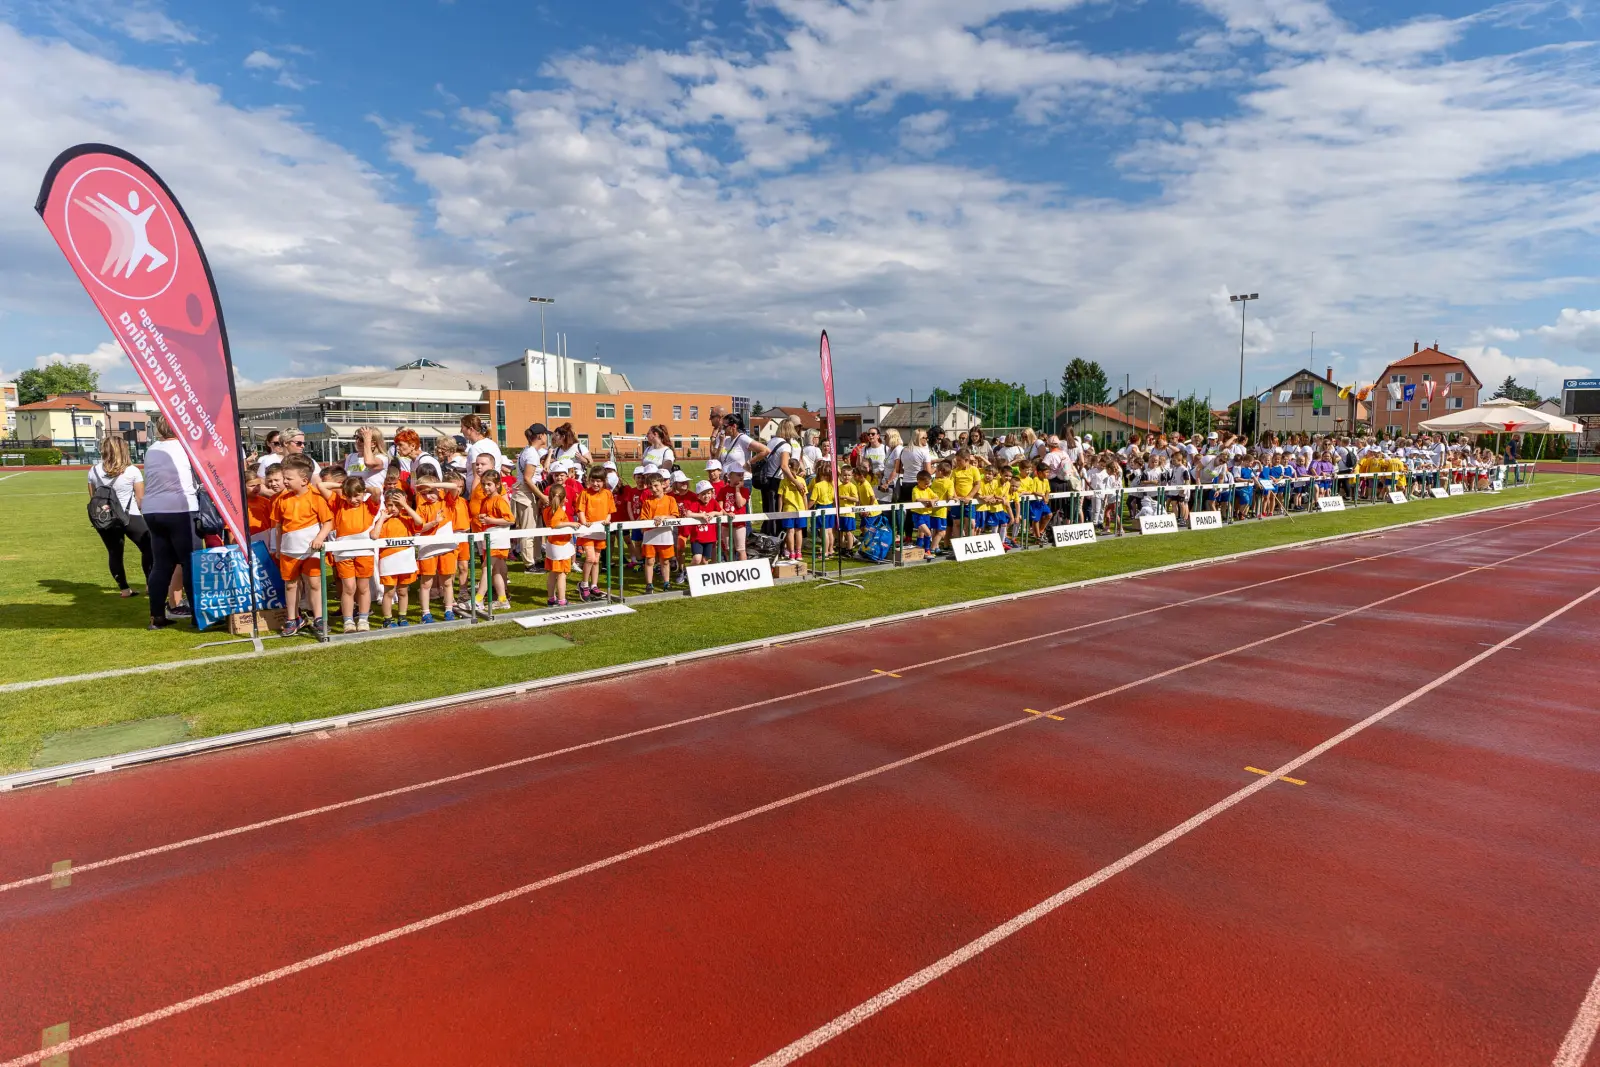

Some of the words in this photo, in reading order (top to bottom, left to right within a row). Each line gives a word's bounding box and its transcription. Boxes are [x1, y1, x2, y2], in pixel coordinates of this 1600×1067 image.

[1195, 516, 1217, 526] PANDA
[1056, 529, 1094, 543] BIŠKUPEC
[964, 540, 996, 555] ALEJA
[701, 567, 761, 587] PINOKIO
[200, 586, 277, 611] SLEEPING
[541, 608, 613, 622] HUNGARY
